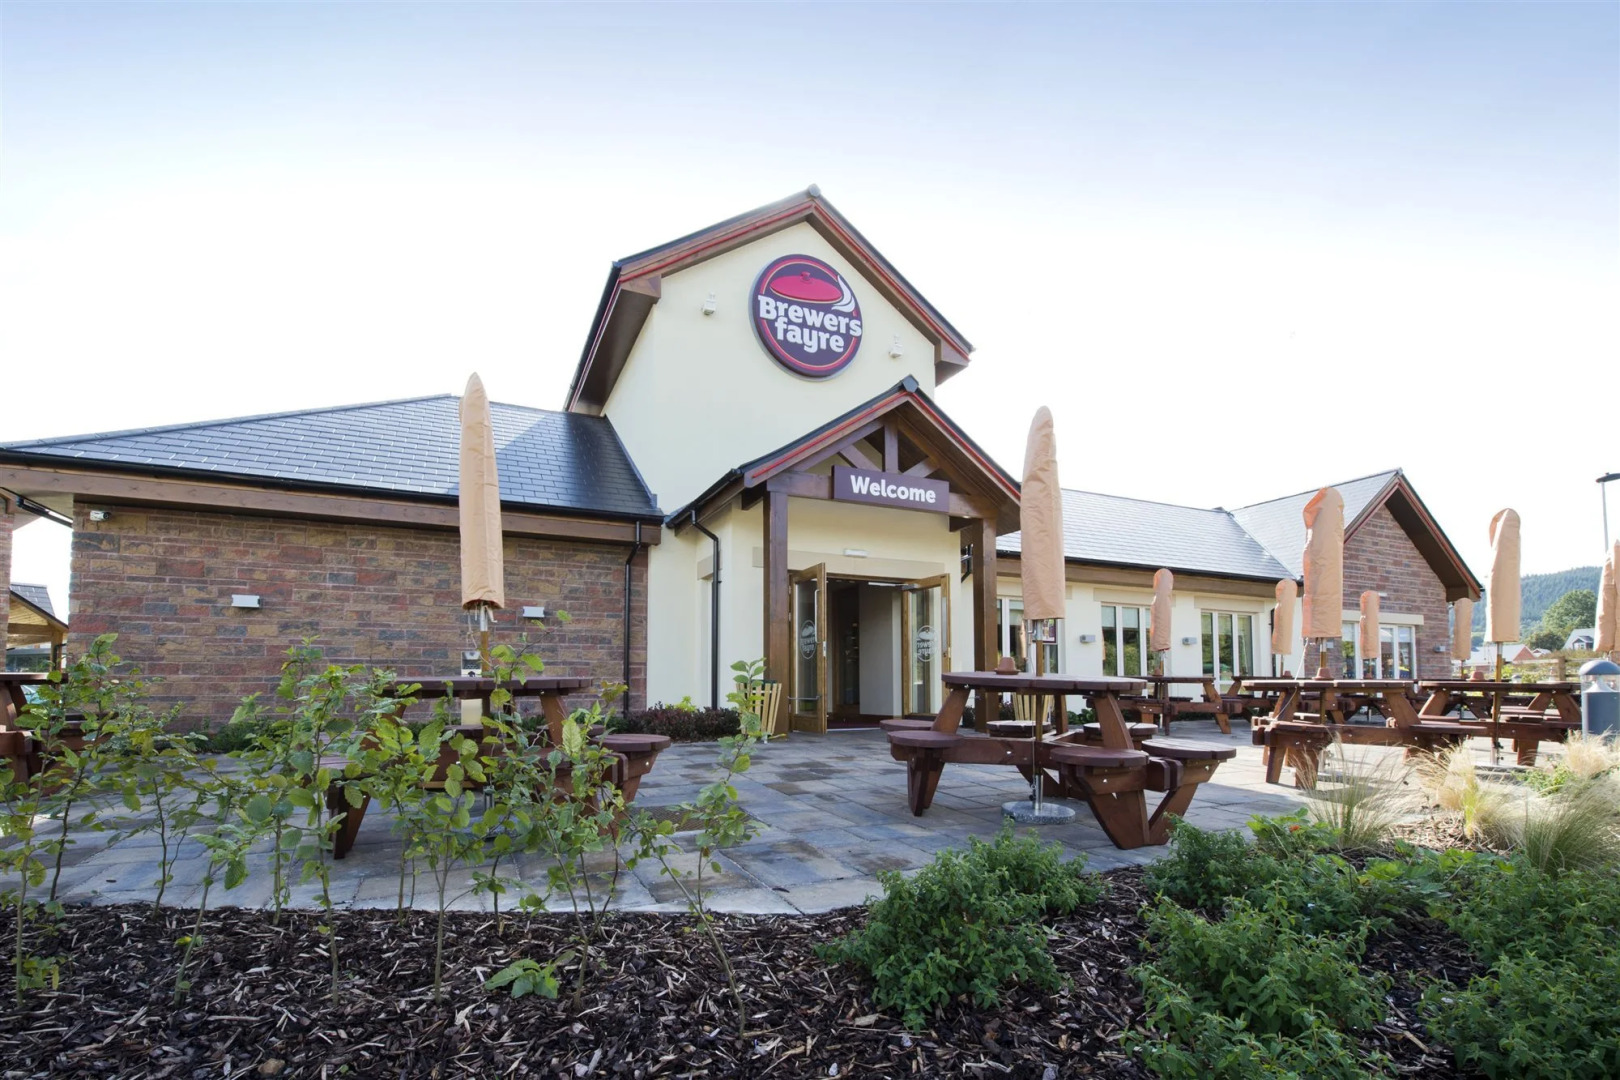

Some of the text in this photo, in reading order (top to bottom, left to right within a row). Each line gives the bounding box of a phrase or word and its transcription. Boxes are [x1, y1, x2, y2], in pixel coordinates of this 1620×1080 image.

[757, 294, 862, 337] Brewers
[774, 316, 845, 354] fayre
[850, 474, 937, 504] Welcome
